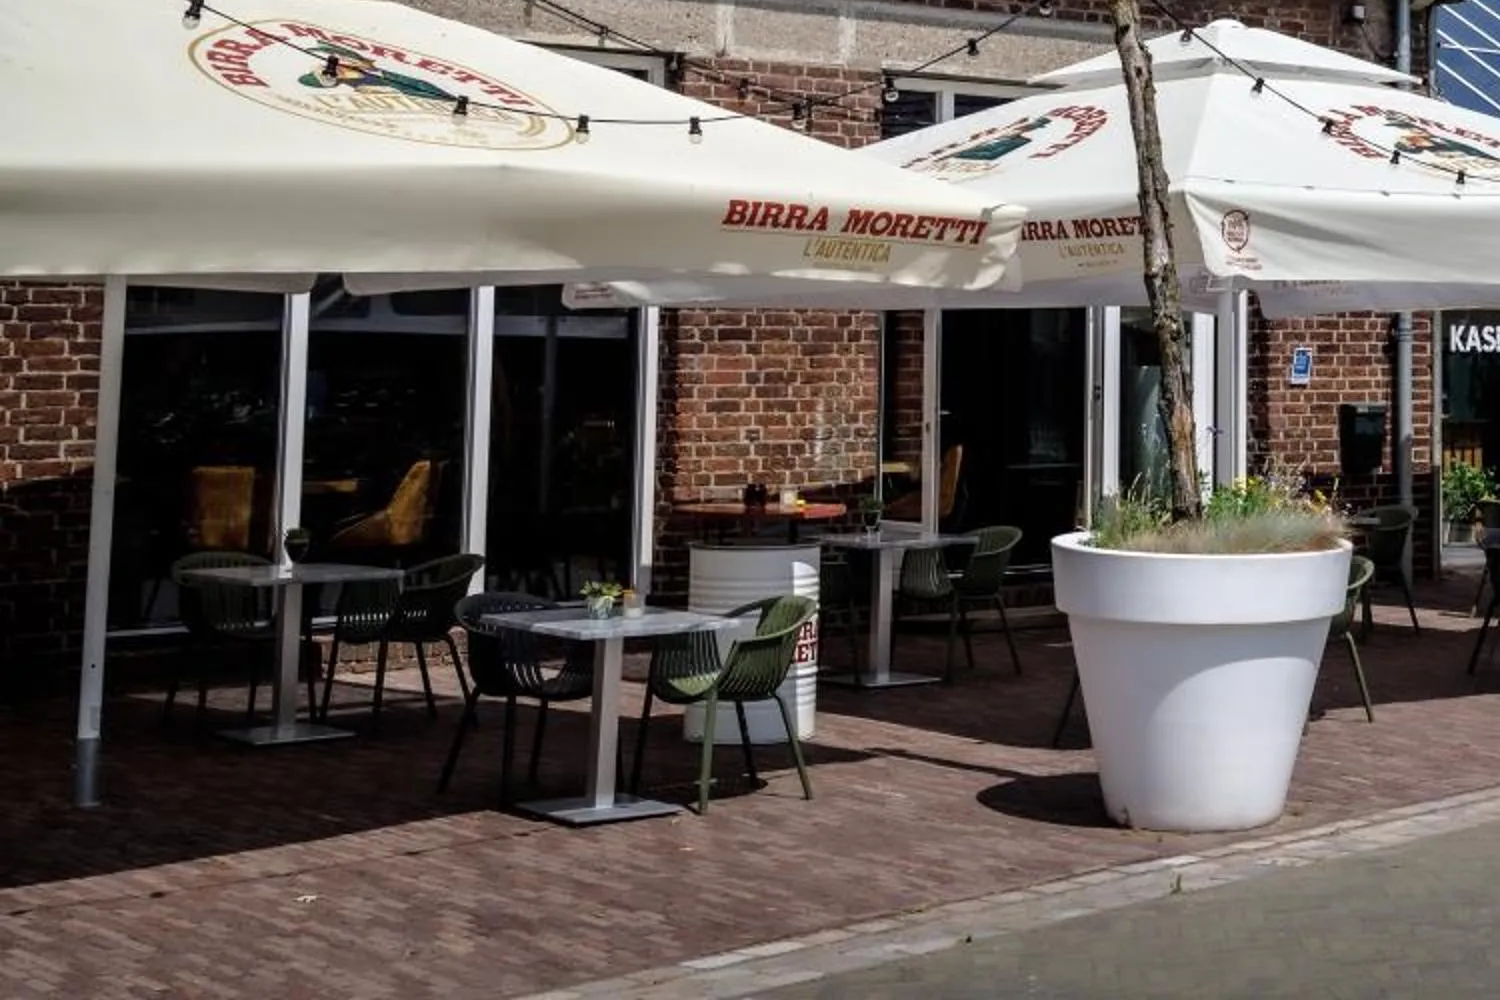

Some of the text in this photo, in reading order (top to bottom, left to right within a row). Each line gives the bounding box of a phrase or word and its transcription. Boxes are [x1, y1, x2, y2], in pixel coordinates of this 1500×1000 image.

[206, 23, 537, 108] BIRRA MORETTI
[721, 199, 989, 245] BIRRA MORETTI
[1021, 215, 1147, 242] IRRA MORET
[803, 238, 892, 264] L'AUTENTICA
